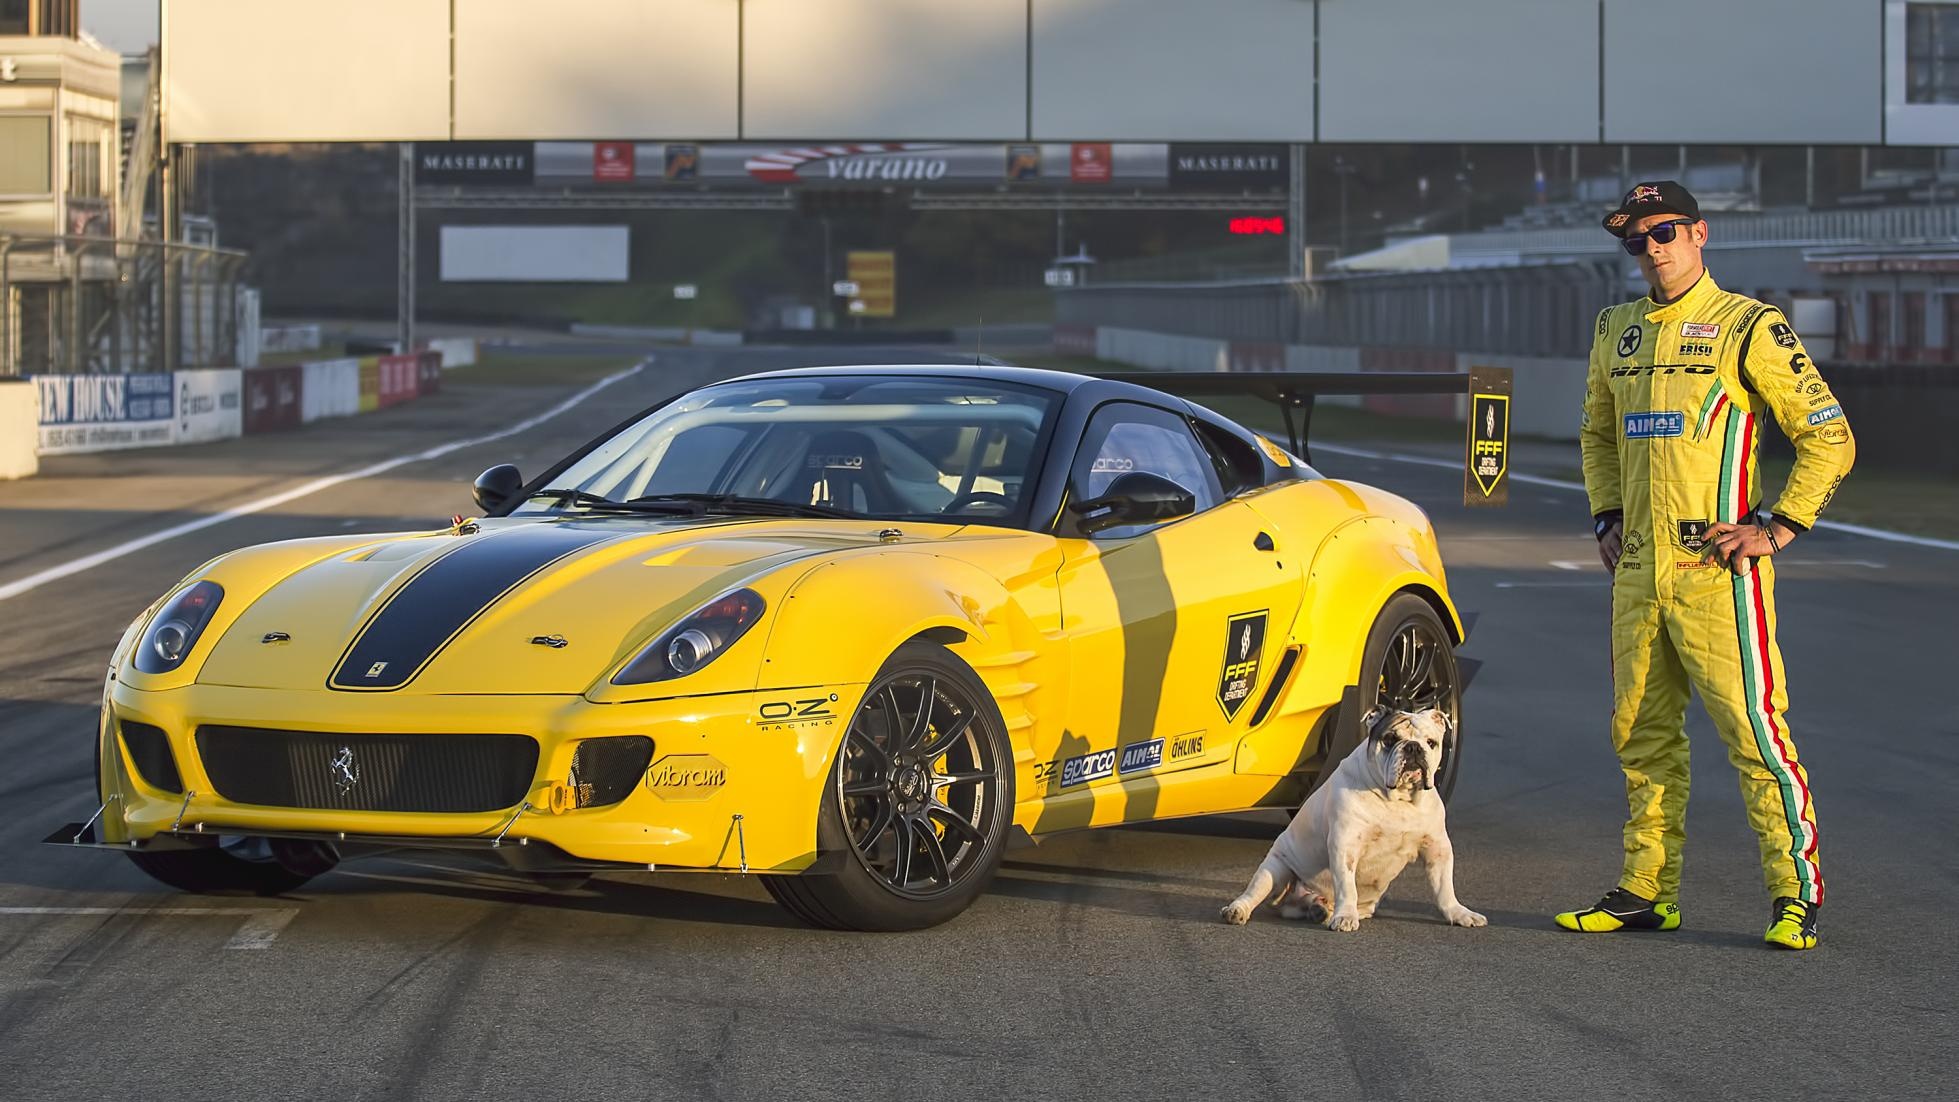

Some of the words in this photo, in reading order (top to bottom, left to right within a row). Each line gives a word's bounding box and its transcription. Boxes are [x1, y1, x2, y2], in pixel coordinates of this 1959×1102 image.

[423, 156, 523, 169] MASERATI
[827, 157, 946, 180] varano
[1178, 157, 1279, 170] MASERATI
[1611, 364, 1716, 378] NITTO
[73, 376, 125, 421] HOUSE
[1475, 440, 1503, 456] FFF
[1224, 660, 1257, 682] FFF
[761, 720, 833, 732] RACING
[1171, 736, 1203, 758] ÖHLINS
[650, 765, 726, 787] vibram
[1063, 750, 1116, 785] sparco
